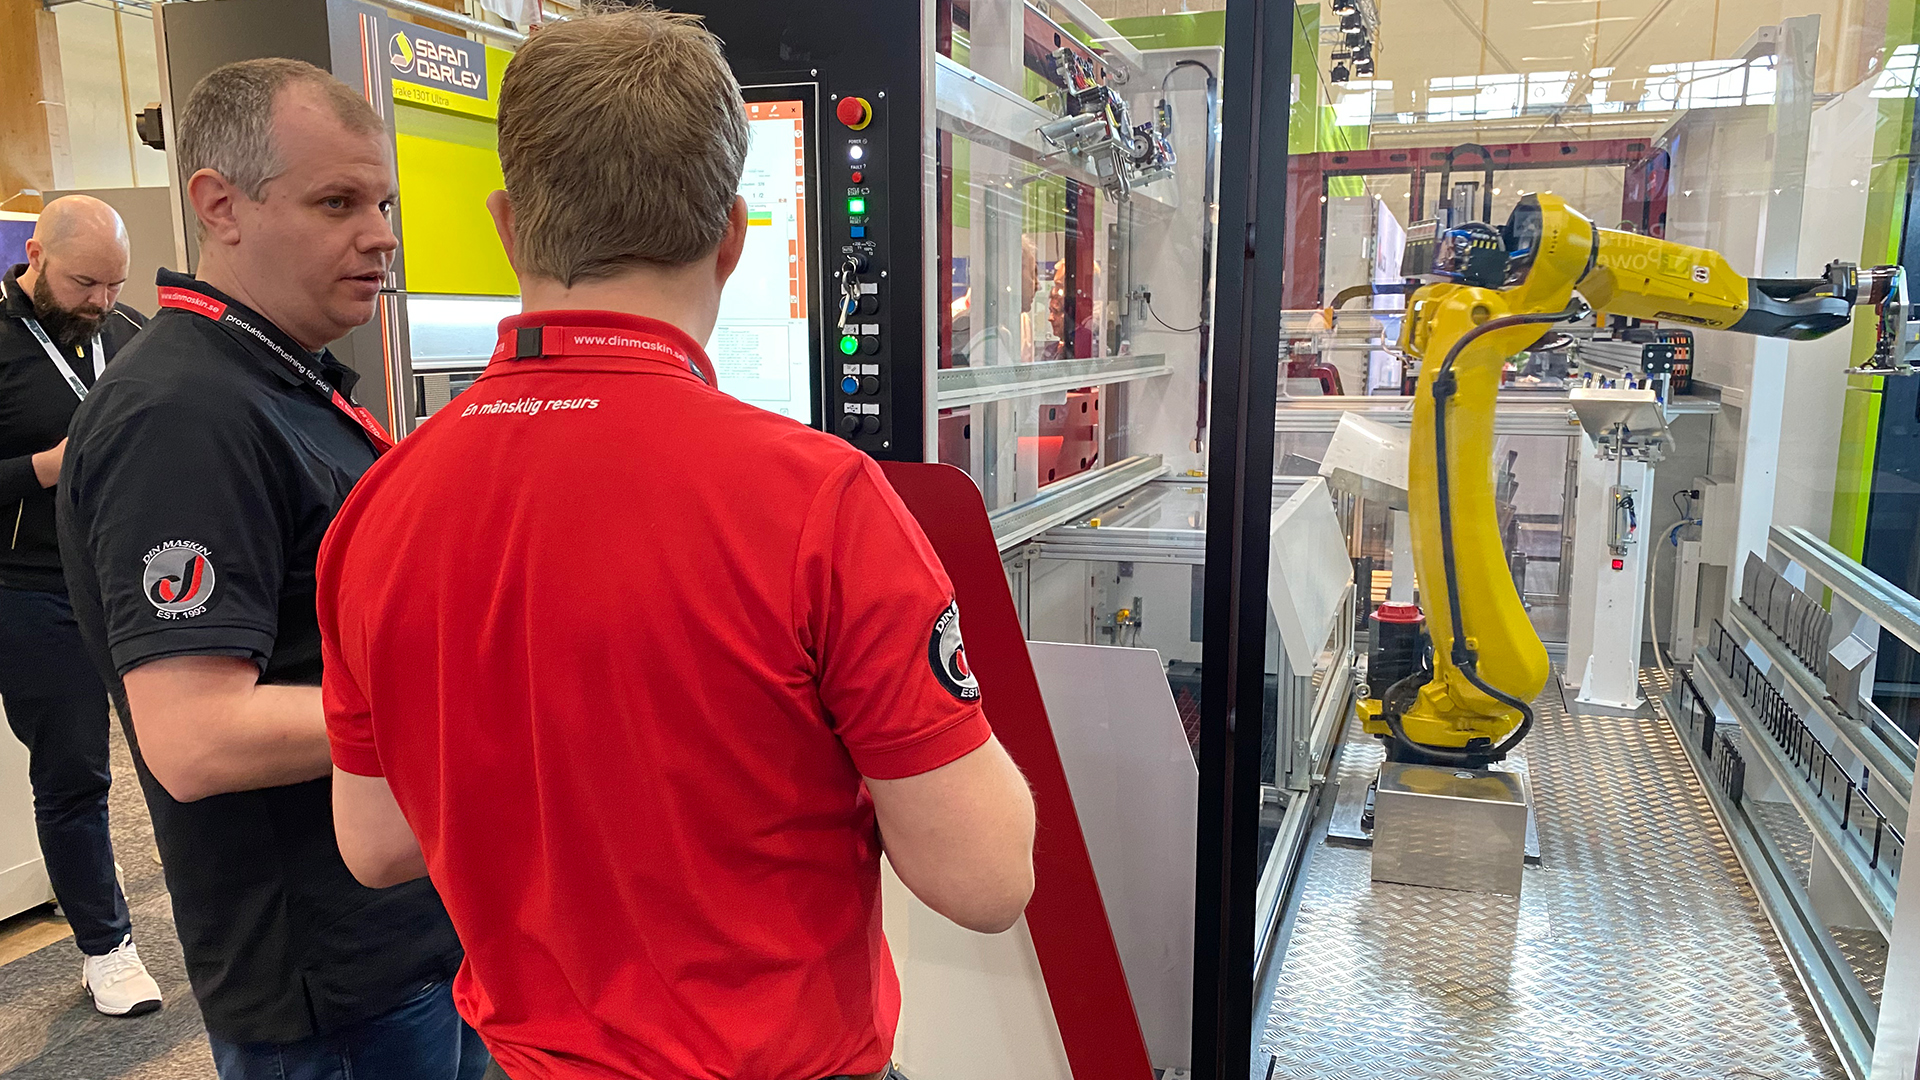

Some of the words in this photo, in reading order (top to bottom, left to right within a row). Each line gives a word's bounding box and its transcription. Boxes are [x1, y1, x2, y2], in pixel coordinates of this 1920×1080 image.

[394, 86, 412, 99] rake
[412, 89, 430, 102] 130T
[431, 92, 450, 106] Ultra
[225, 314, 306, 374] produktionsutrustning
[574, 335, 685, 362] www.dinmaskin.se
[461, 403, 476, 417] En
[478, 397, 542, 416] mänsklig
[544, 397, 600, 412] resurs
[142, 545, 161, 565] DIN
[162, 539, 212, 557] MASKIN
[156, 609, 180, 620] EST.
[182, 605, 207, 619] 1993
[934, 608, 954, 634] DIN
